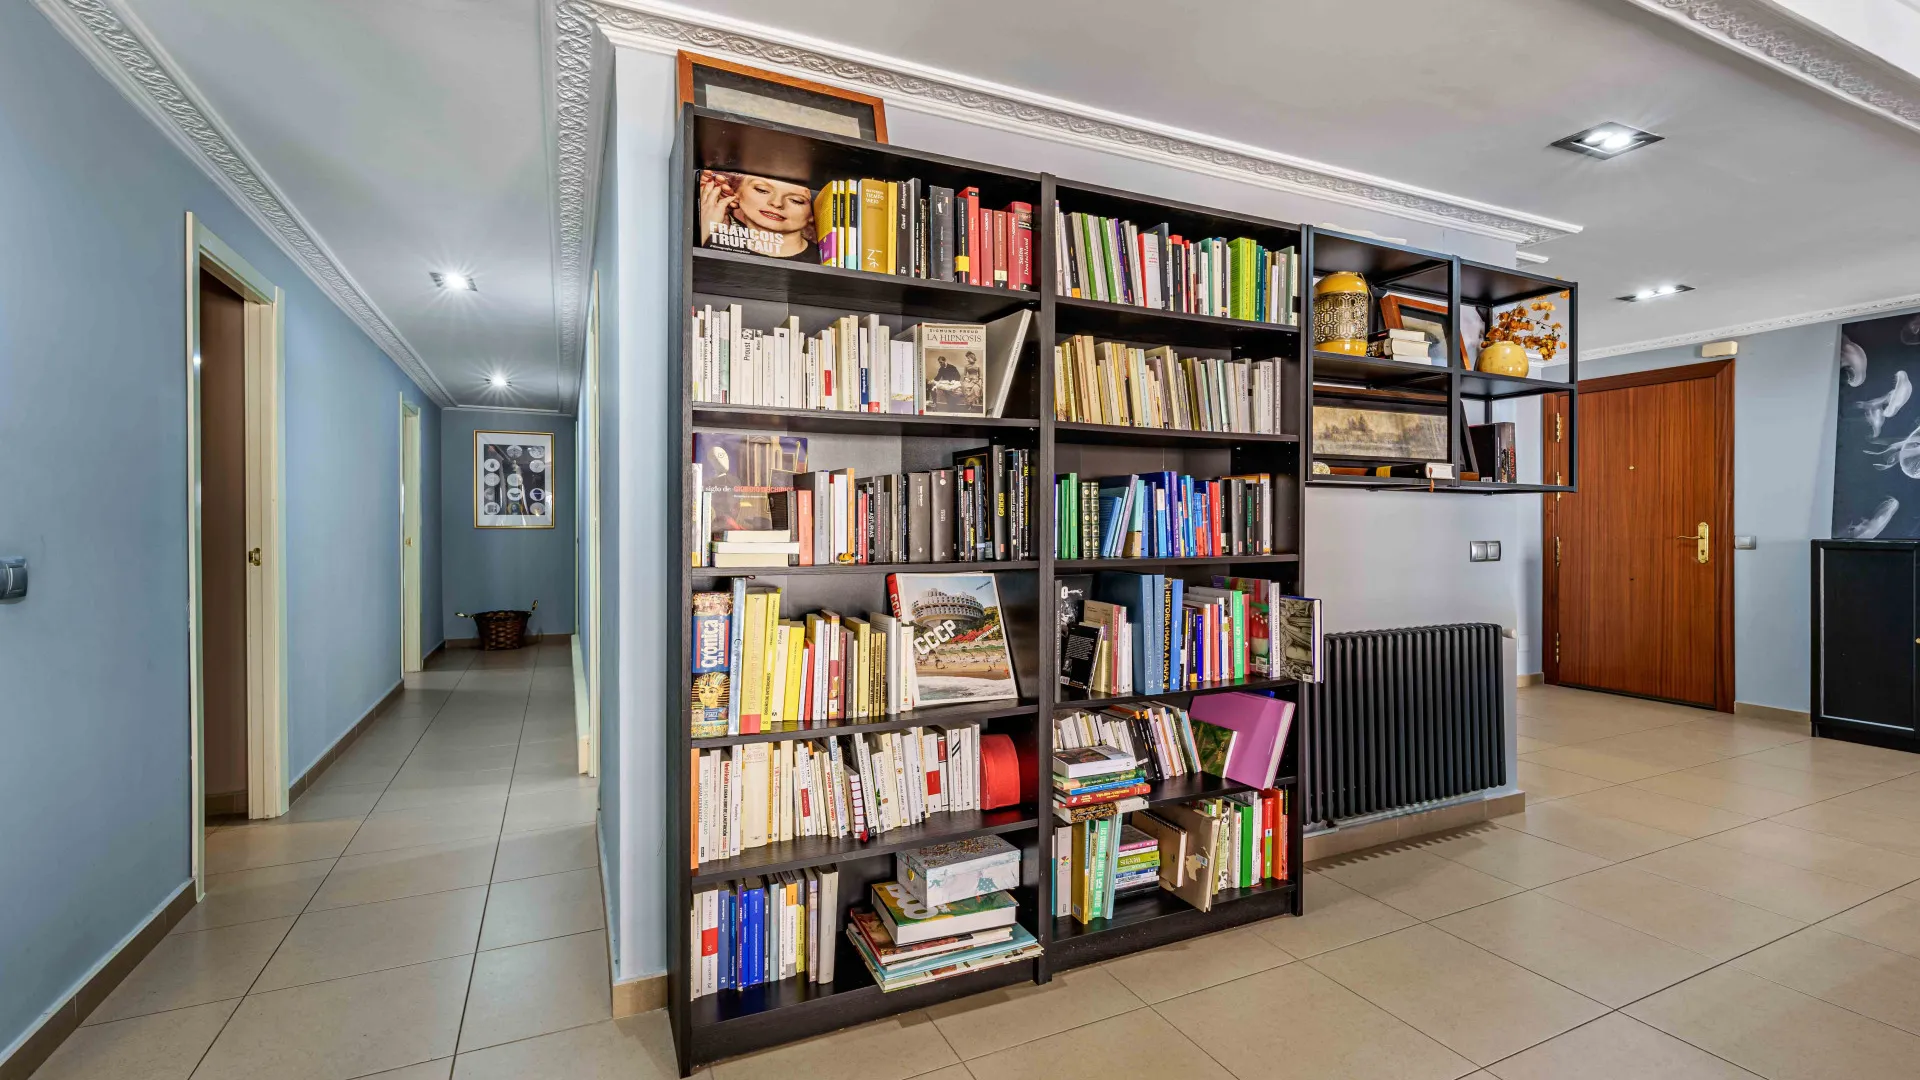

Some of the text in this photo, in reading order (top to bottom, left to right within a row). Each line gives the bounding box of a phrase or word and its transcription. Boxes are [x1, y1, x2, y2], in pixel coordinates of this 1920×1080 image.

[709, 221, 785, 245] FRANÇOIS
[709, 232, 783, 255] TRUFFAUT
[927, 333, 982, 343] LA HIPNOSIS
[743, 342, 751, 361] Proust
[705, 485, 721, 494] siglo
[890, 593, 903, 620] CCC
[700, 619, 718, 669] Crónica
[913, 619, 957, 656] CCCP
